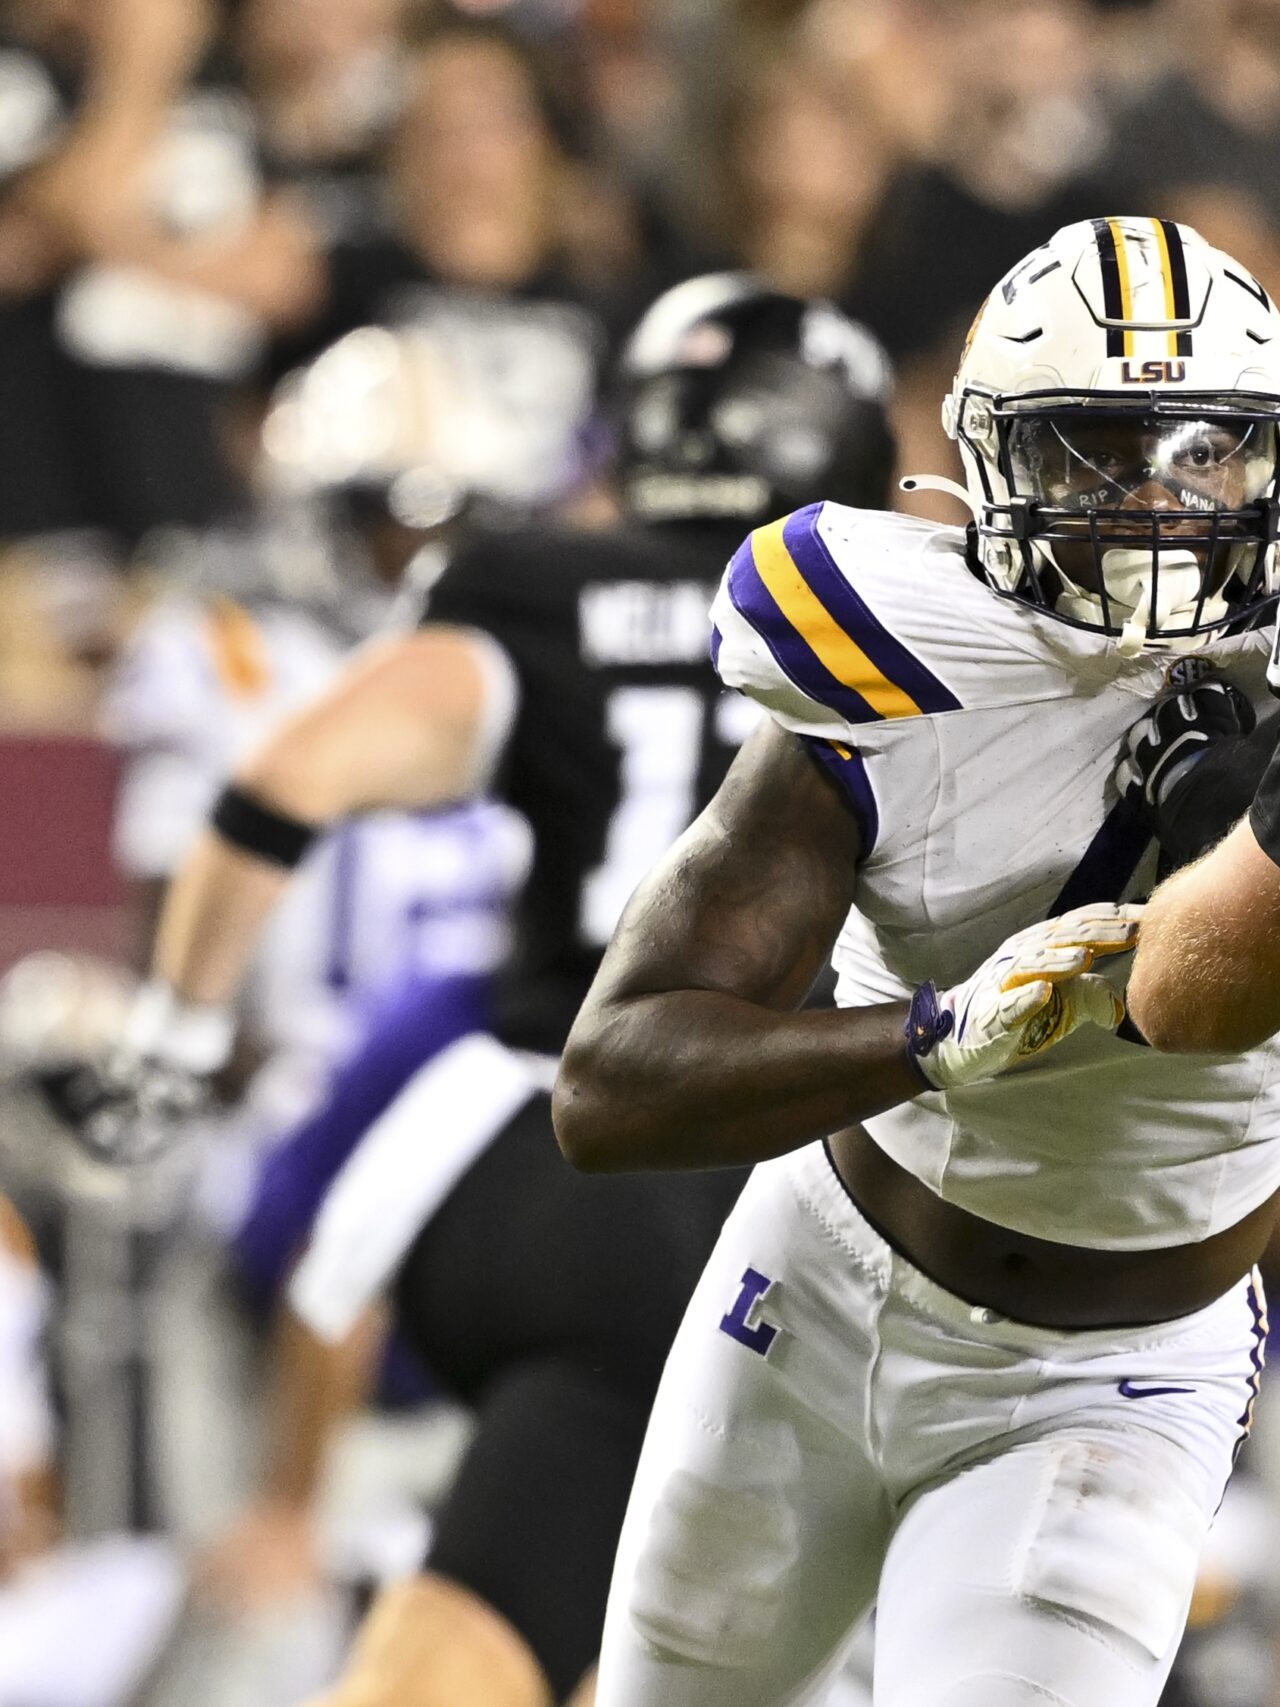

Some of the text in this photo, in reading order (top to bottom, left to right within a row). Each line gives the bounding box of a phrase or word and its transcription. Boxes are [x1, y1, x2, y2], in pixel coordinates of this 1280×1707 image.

[1121, 361, 1186, 384] LSU
[1079, 489, 1108, 507] RIP
[1180, 489, 1215, 511] NANA
[717, 1266, 781, 1359] L
